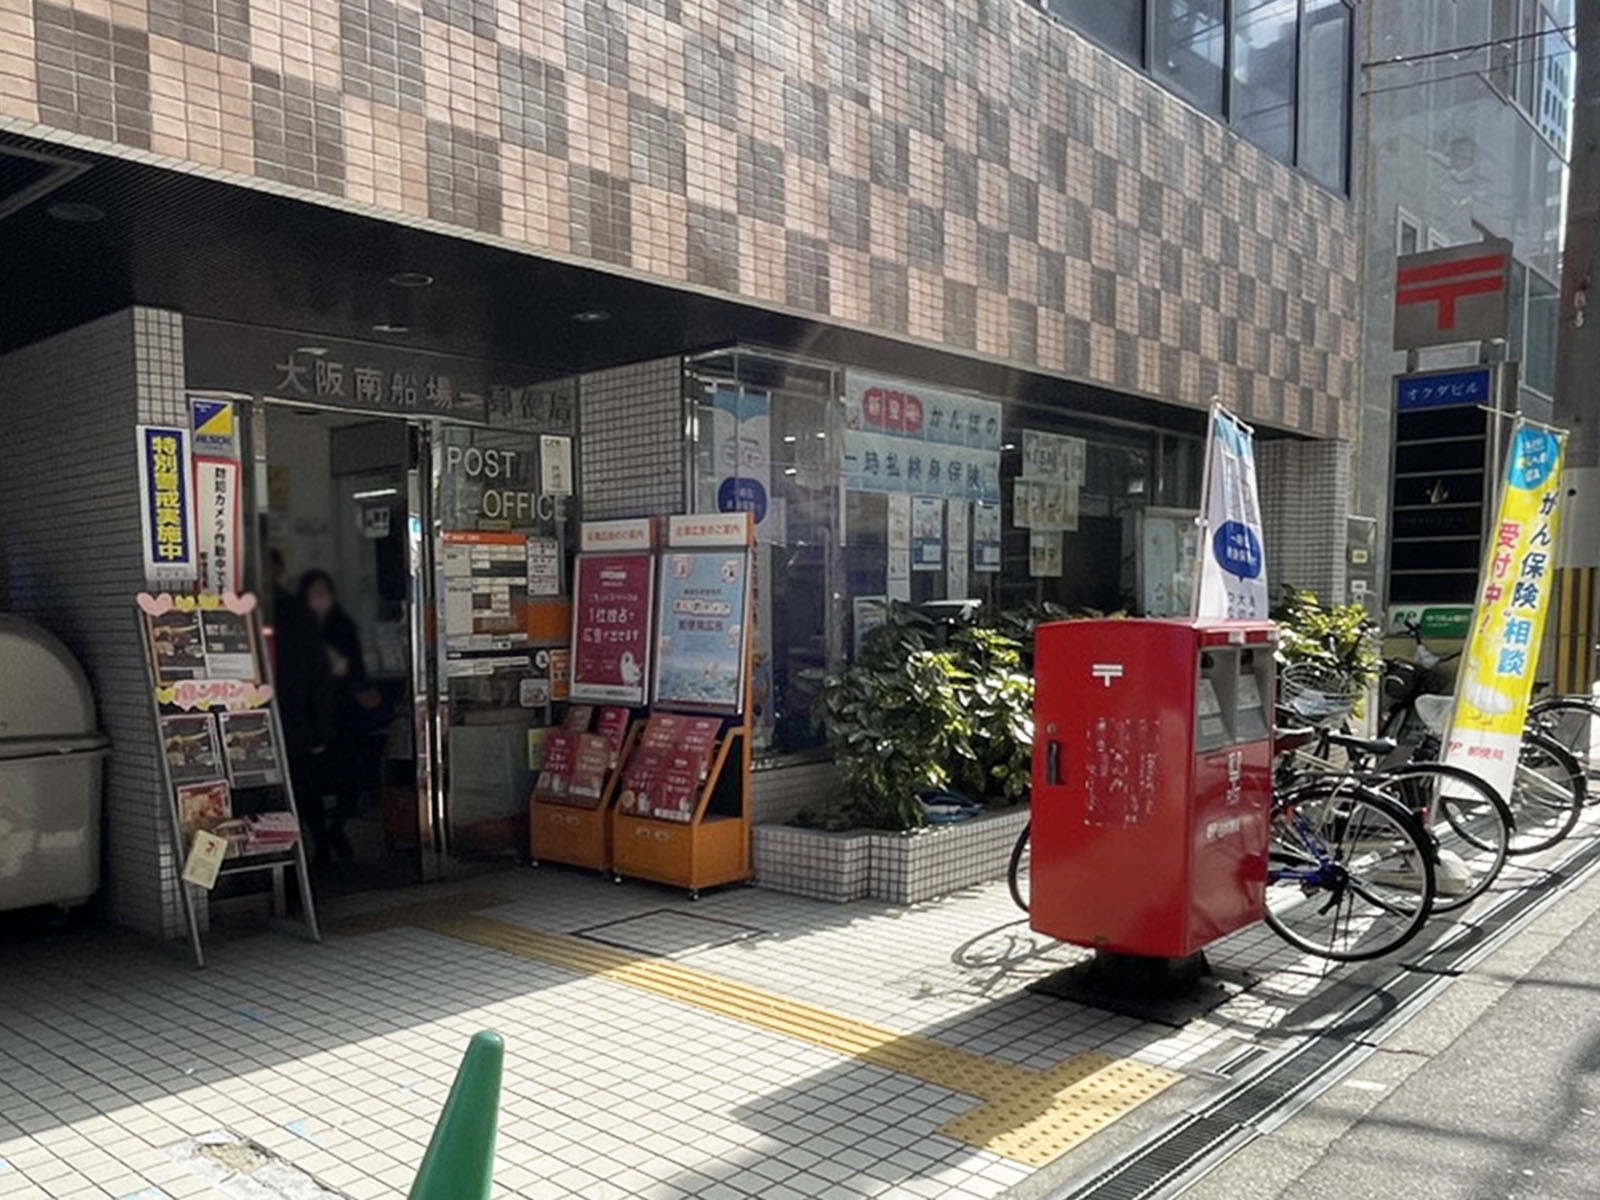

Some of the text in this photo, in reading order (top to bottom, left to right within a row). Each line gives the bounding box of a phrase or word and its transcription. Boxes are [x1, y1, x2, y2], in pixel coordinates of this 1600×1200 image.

[1406, 382, 1479, 401] オクダビル
[446, 445, 516, 479] POST
[151, 435, 183, 561] 特別警戒実施中
[482, 490, 568, 522] OFFICE
